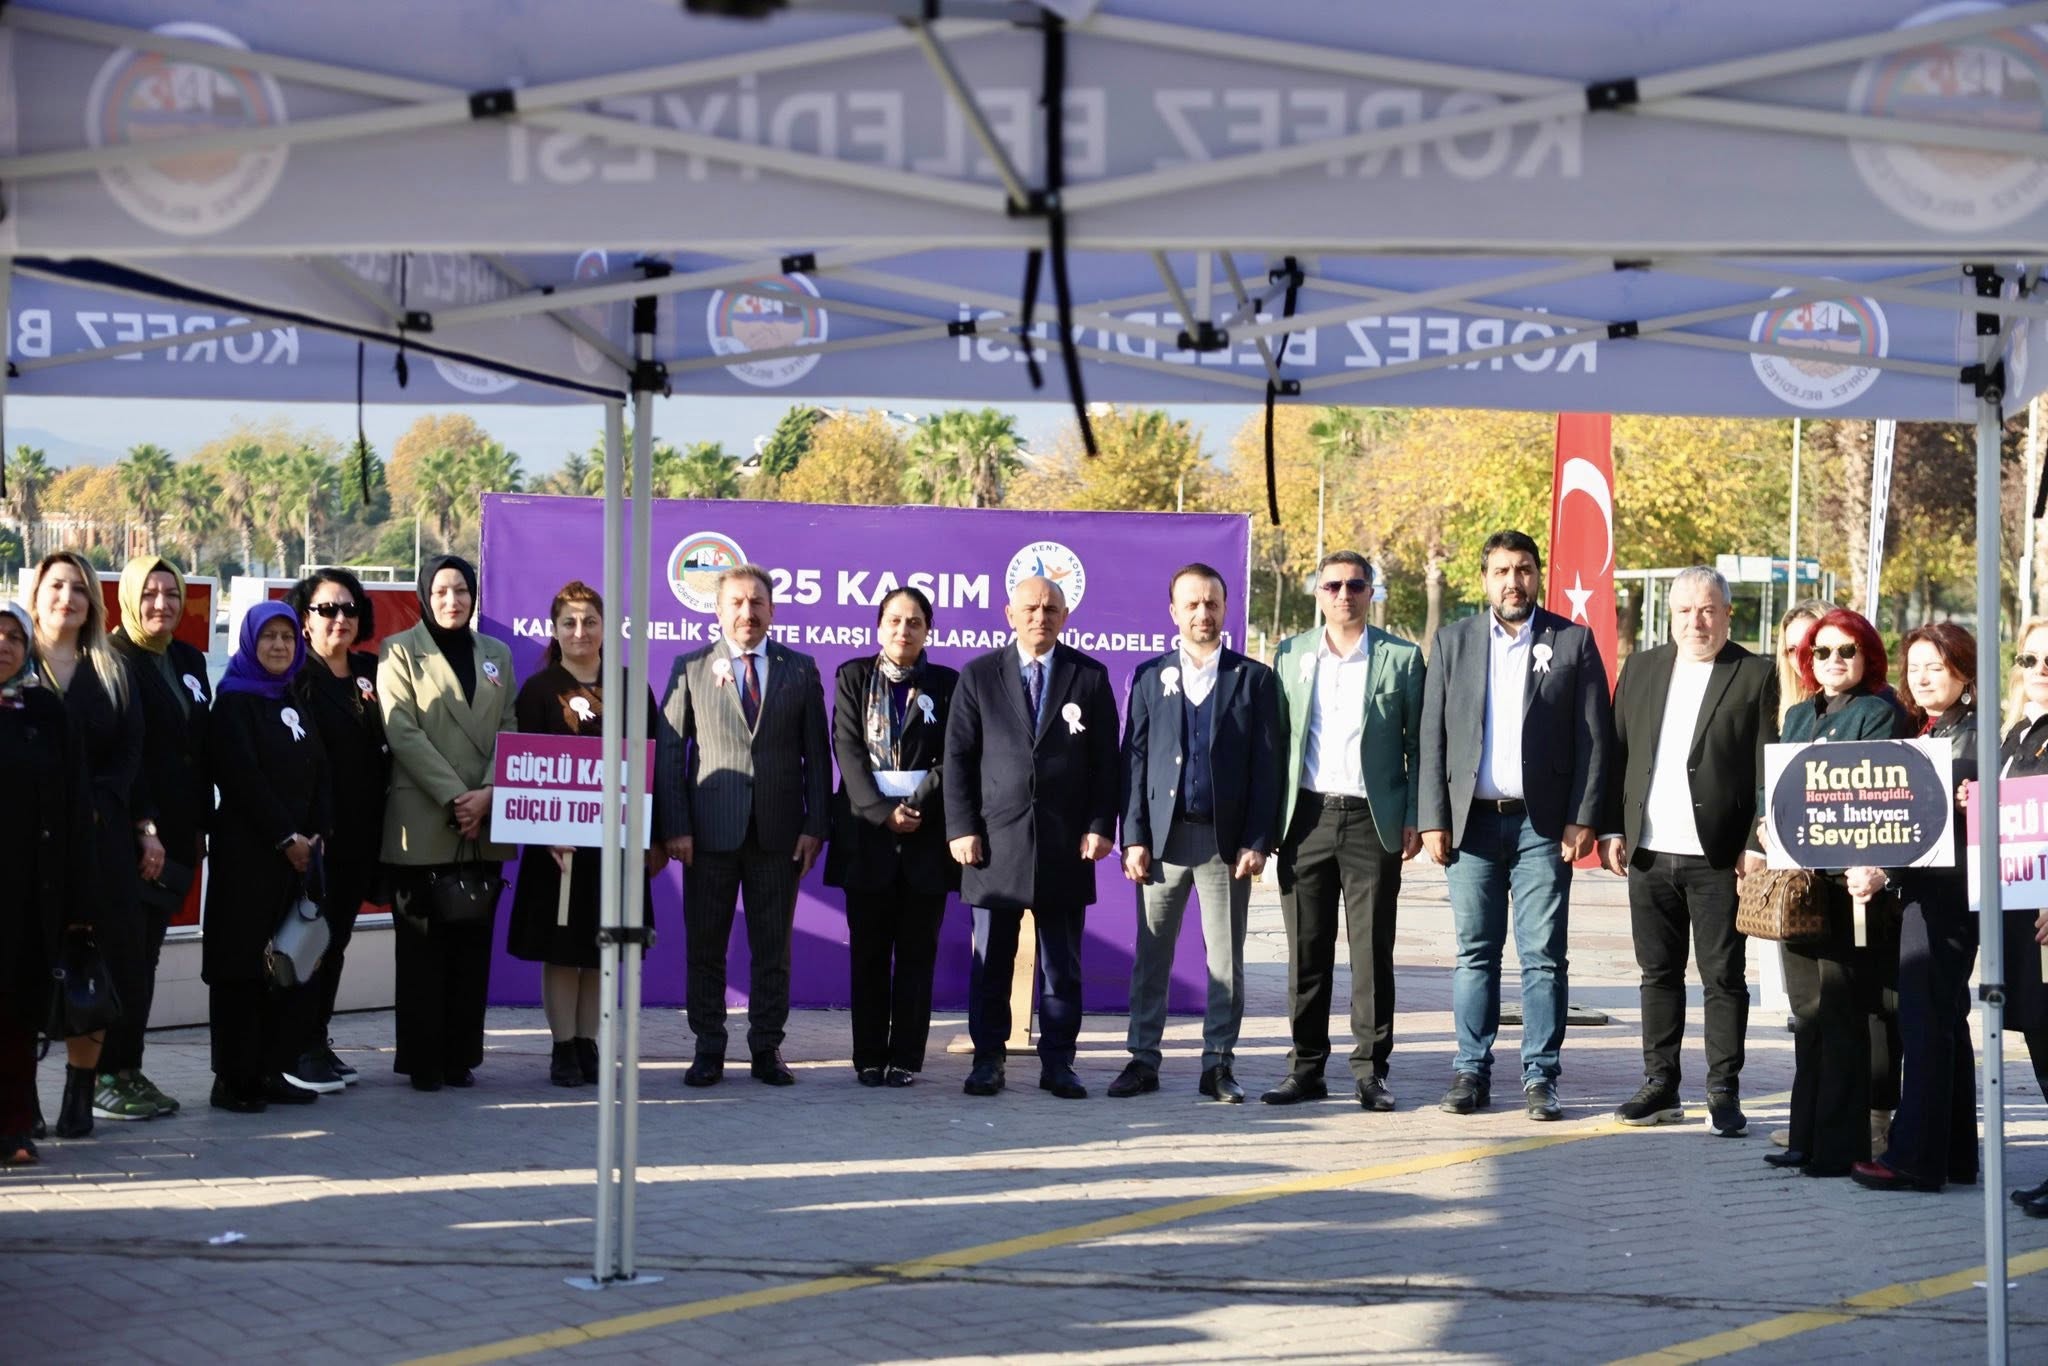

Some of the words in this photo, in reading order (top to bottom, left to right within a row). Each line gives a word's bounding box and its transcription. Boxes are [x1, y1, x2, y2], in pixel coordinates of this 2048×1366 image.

[1031, 544, 1059, 553] KENT
[772, 568, 822, 605] 25
[837, 570, 990, 609] KASIM
[806, 626, 871, 648] KARŞI
[506, 751, 572, 787] GÜÇLÜ
[1805, 759, 1909, 791] Kadın
[1806, 790, 1854, 803] Hayatın
[1859, 788, 1914, 802] Rengidir,
[505, 795, 561, 825] GÜÇLÜ
[1806, 807, 1838, 823] Tek
[1843, 803, 1910, 824] İhtiyacı
[1809, 822, 1912, 849] Sevgidir
